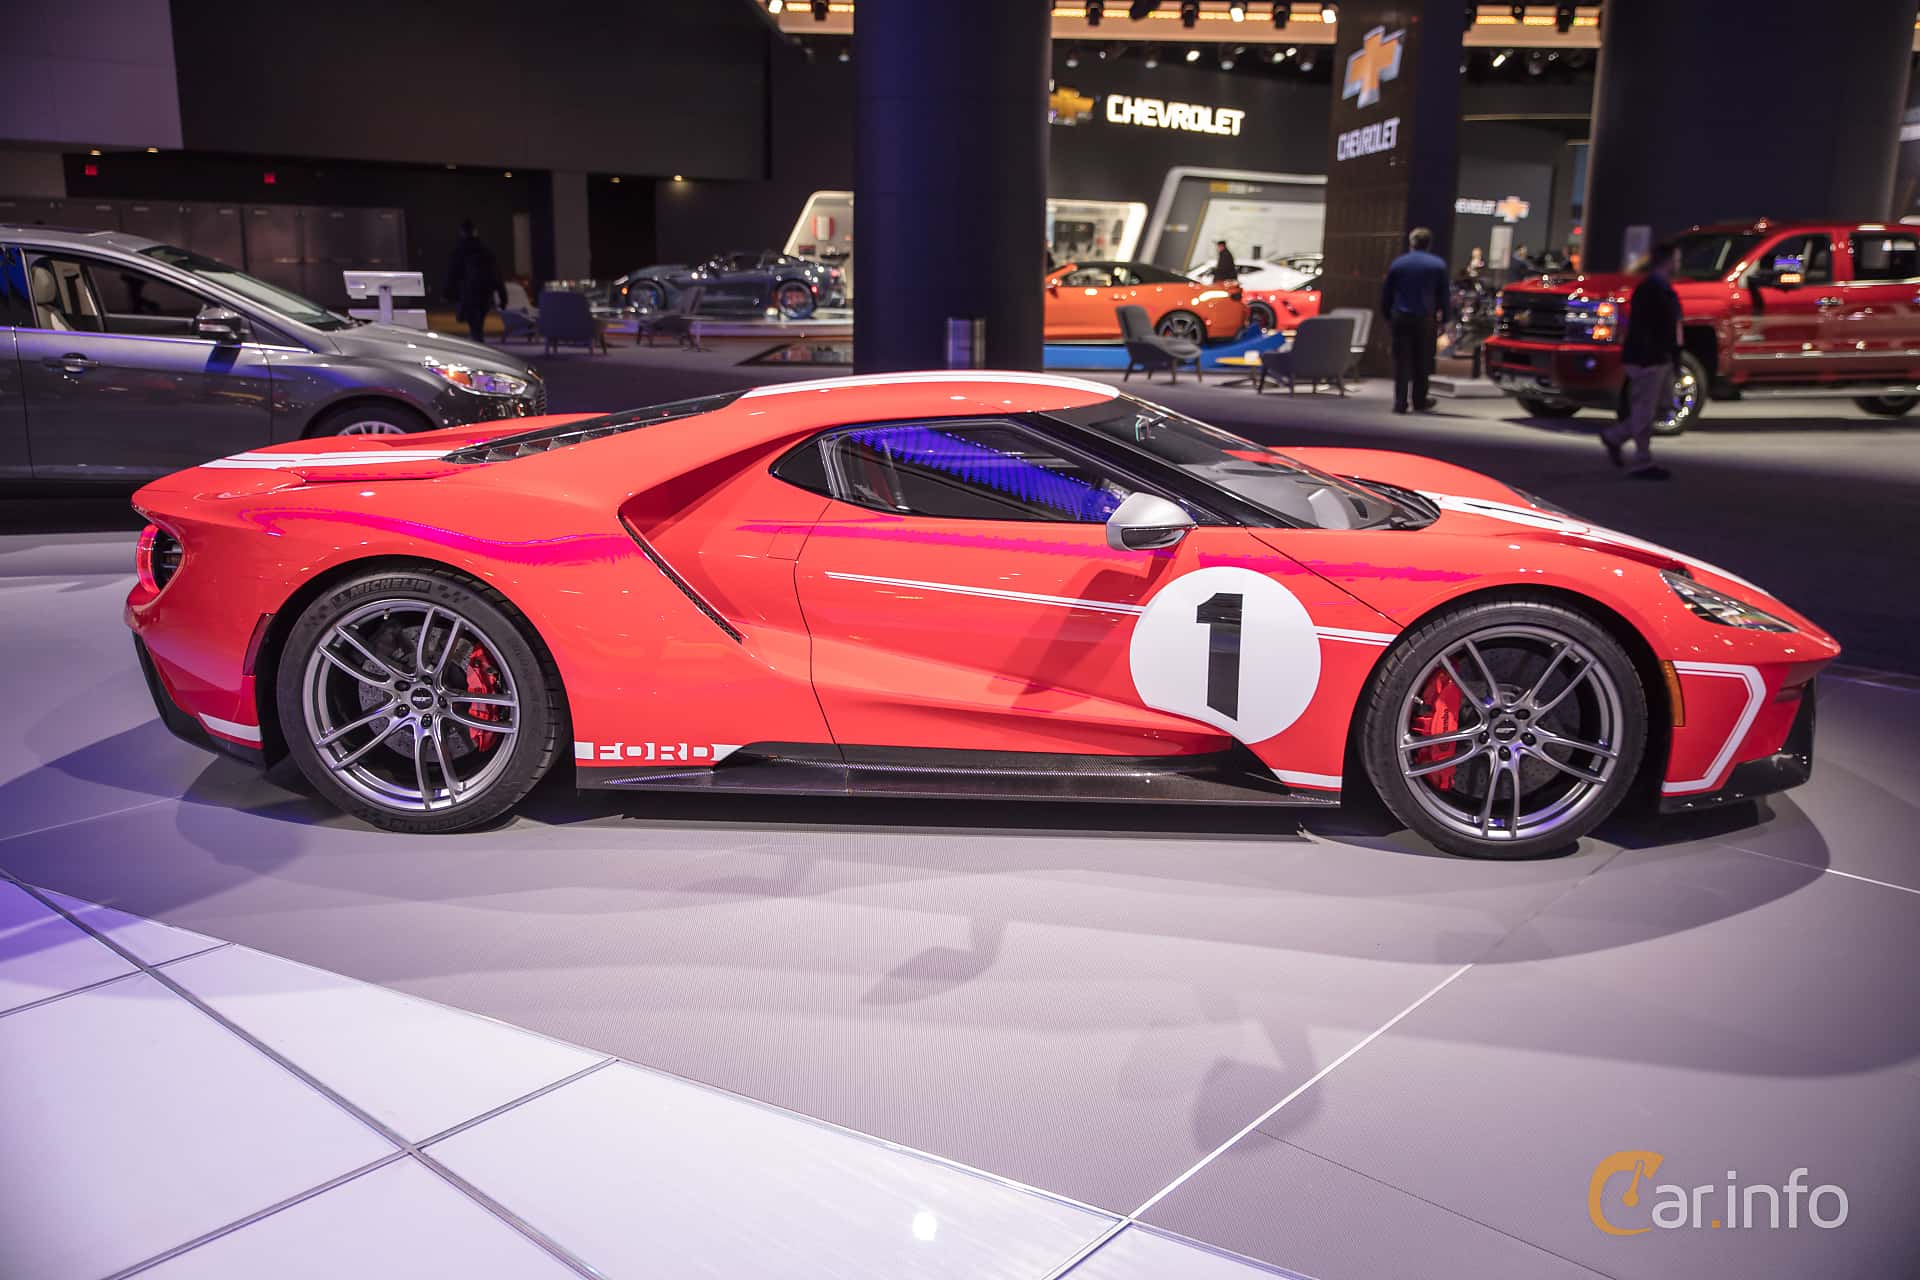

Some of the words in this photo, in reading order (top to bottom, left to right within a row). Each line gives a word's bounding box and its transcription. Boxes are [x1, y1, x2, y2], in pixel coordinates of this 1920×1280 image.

[1106, 94, 1246, 136] CHEVROLET
[1337, 117, 1400, 161] CHEVROLET
[350, 578, 433, 596] MICHELIN
[1196, 592, 1243, 721] 1
[593, 742, 714, 761] FORD
